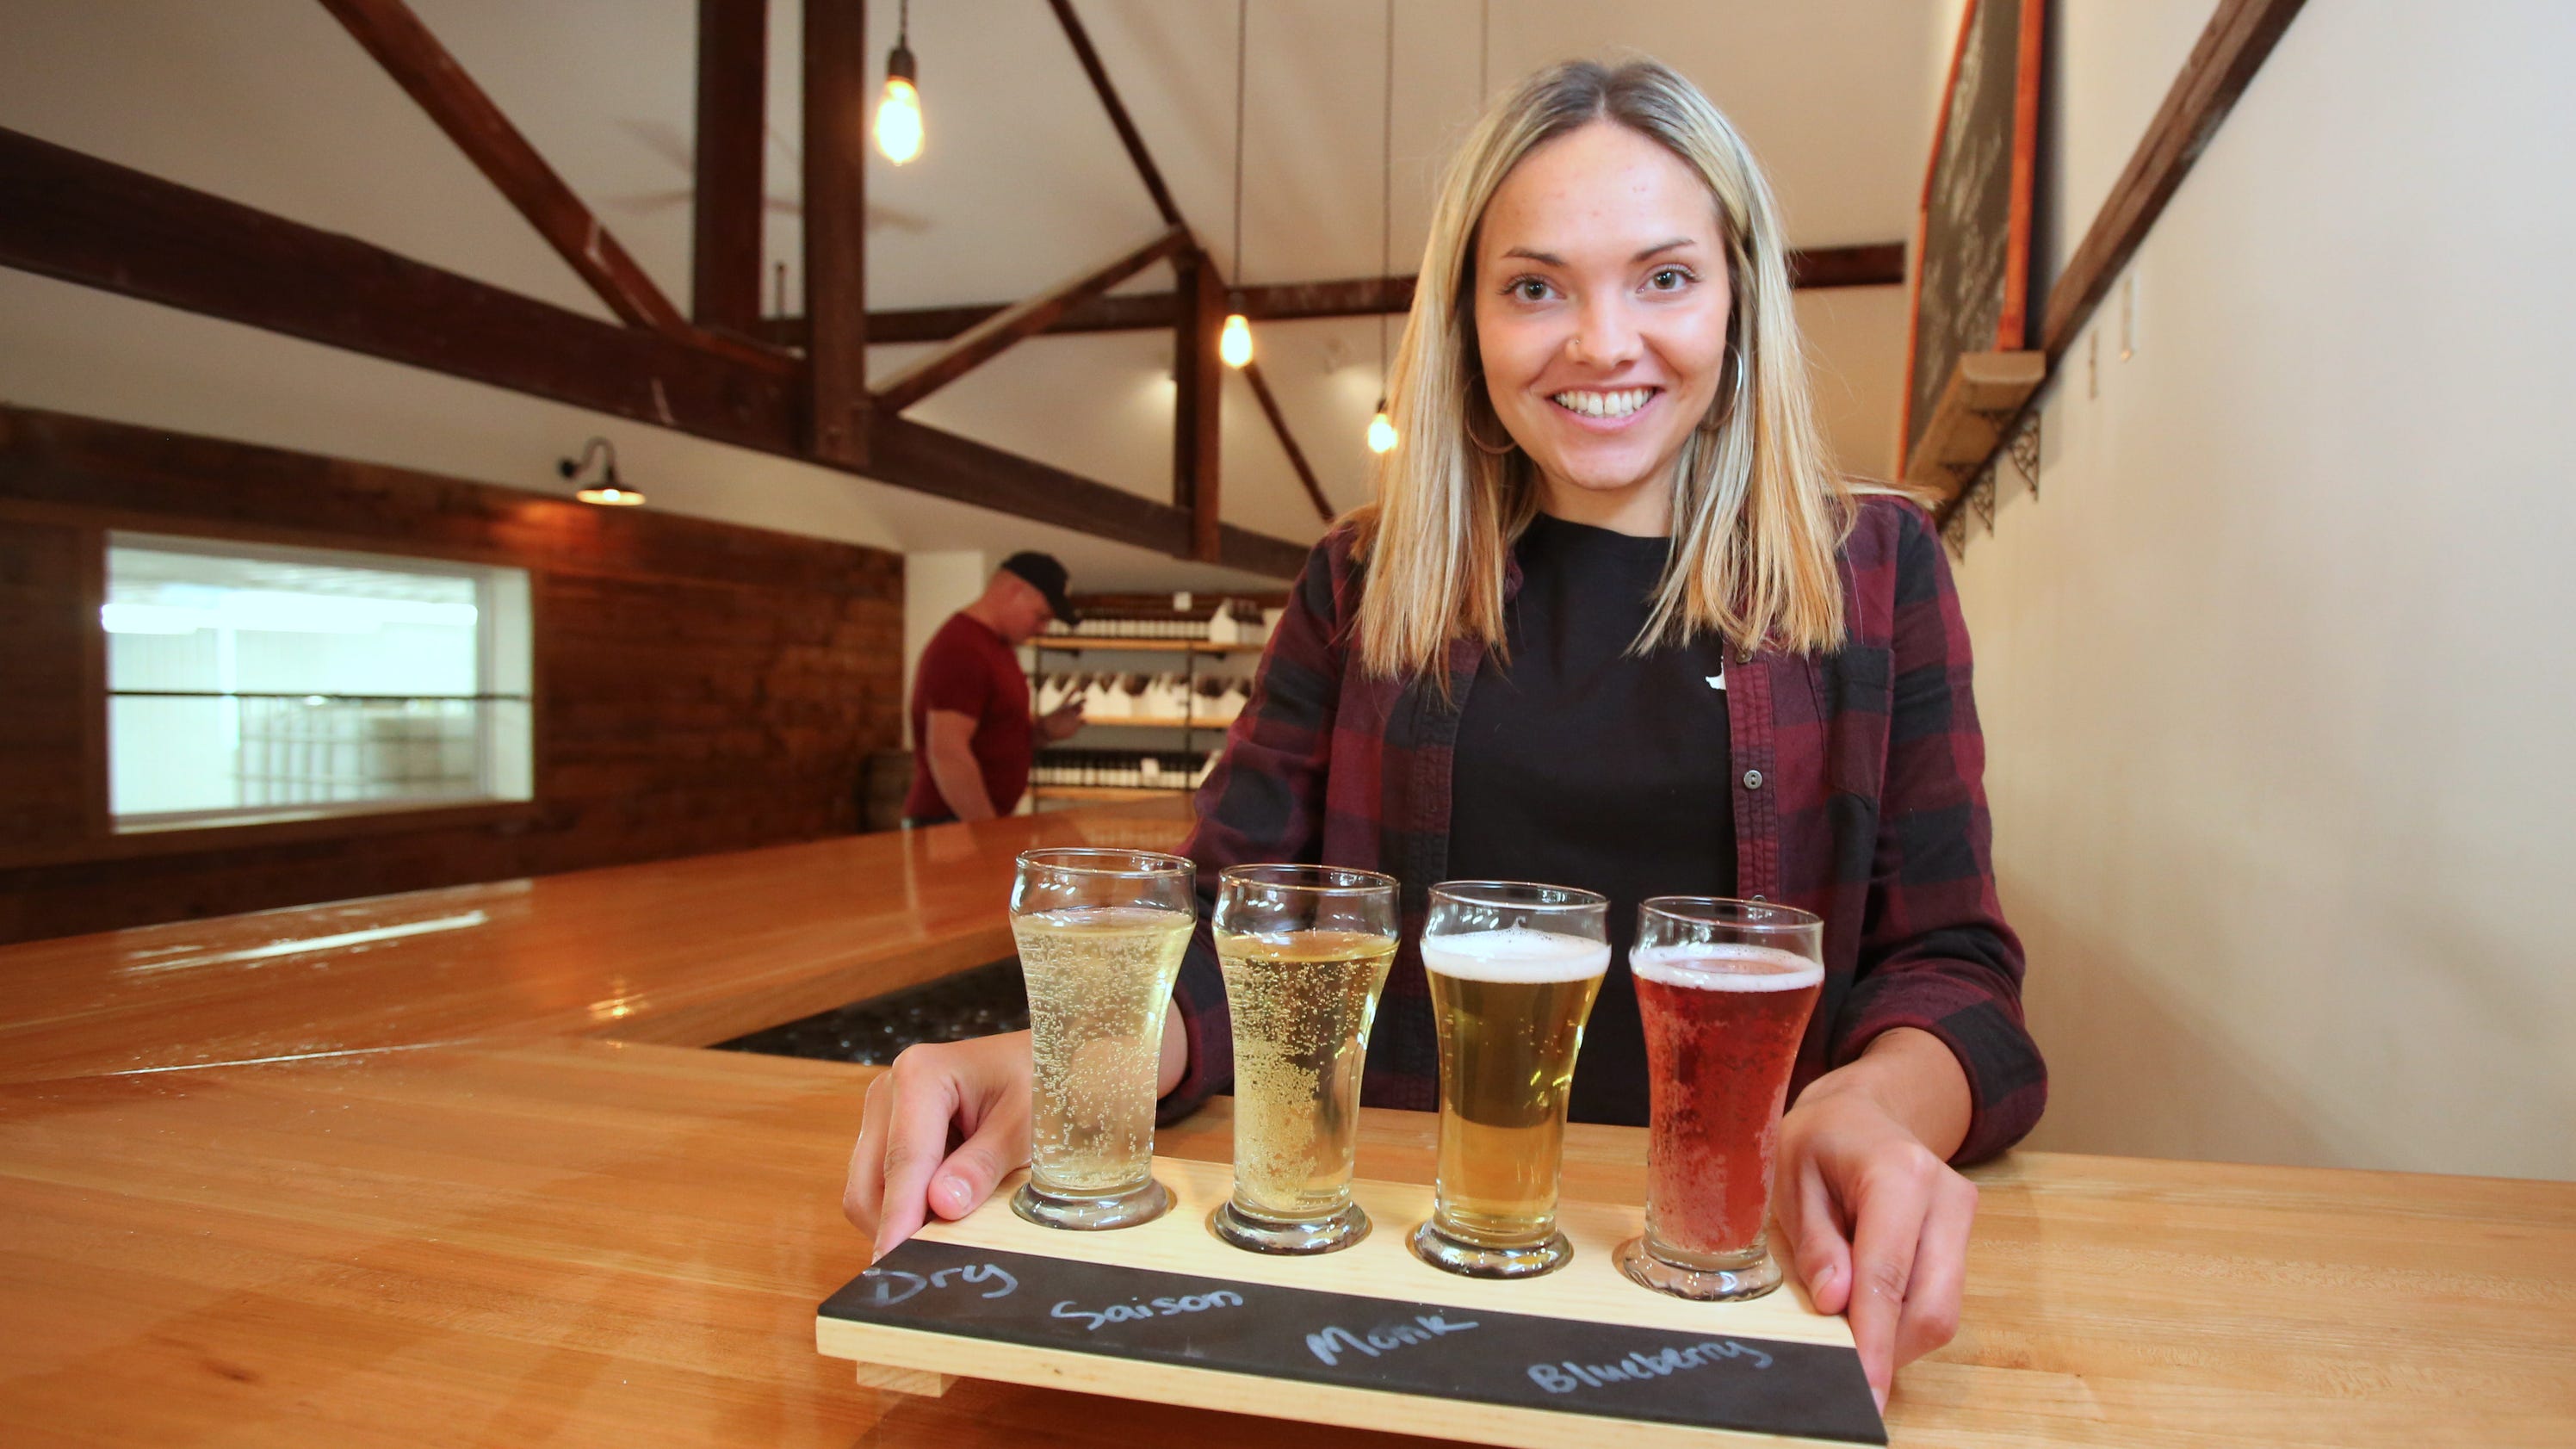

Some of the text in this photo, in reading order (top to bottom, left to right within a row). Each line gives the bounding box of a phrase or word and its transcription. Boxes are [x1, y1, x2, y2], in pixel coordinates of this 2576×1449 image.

[861, 1263, 1019, 1306] Dry
[1049, 1290, 1244, 1332] Saison
[1305, 1315, 1480, 1366] Monk
[1526, 1341, 1774, 1393] Blueberry
